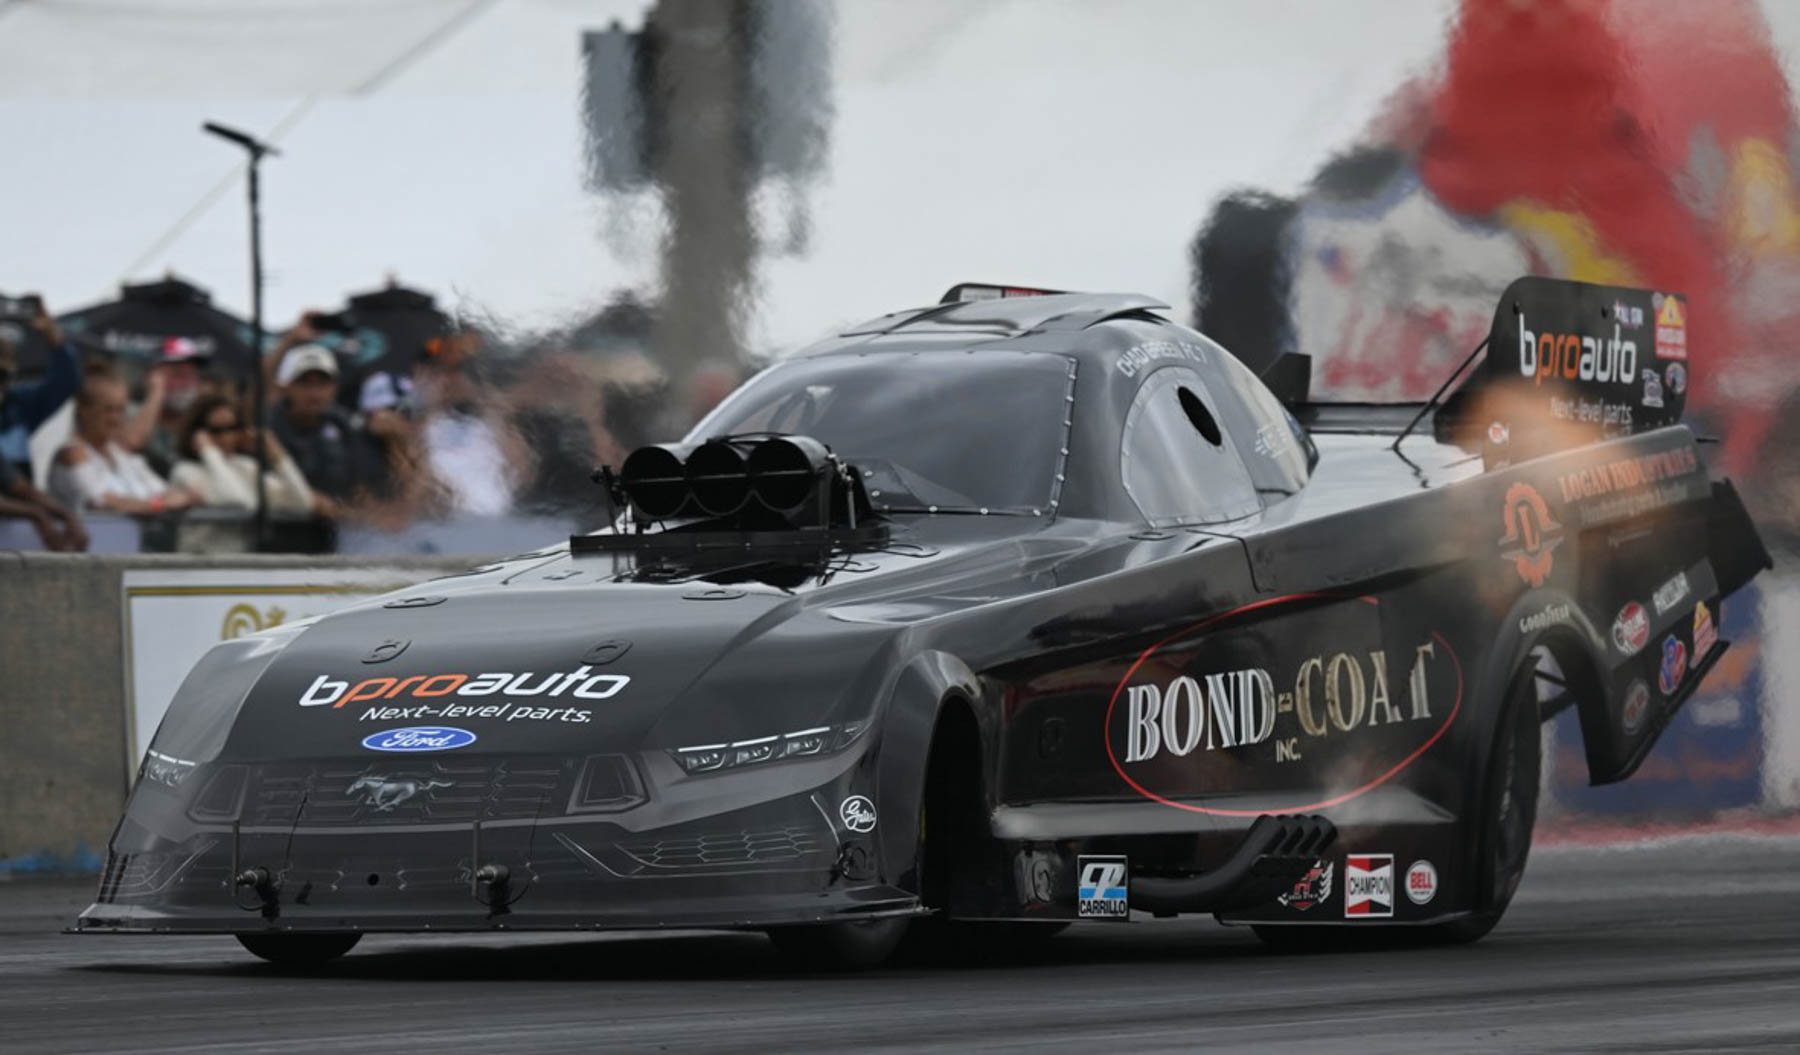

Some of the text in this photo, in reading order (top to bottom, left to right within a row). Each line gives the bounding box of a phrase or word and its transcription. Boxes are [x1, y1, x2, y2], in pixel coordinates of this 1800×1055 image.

[1518, 311, 1637, 388] bproauto
[1116, 346, 1150, 377] CHAD
[298, 665, 632, 708] bproauto
[359, 702, 592, 723] Next-level parts.
[378, 729, 460, 749] Ford
[1276, 737, 1302, 763] INC.
[1349, 875, 1393, 896] CHAMPION
[1410, 871, 1433, 890] BELL
[1080, 899, 1126, 914] CARRILLO
